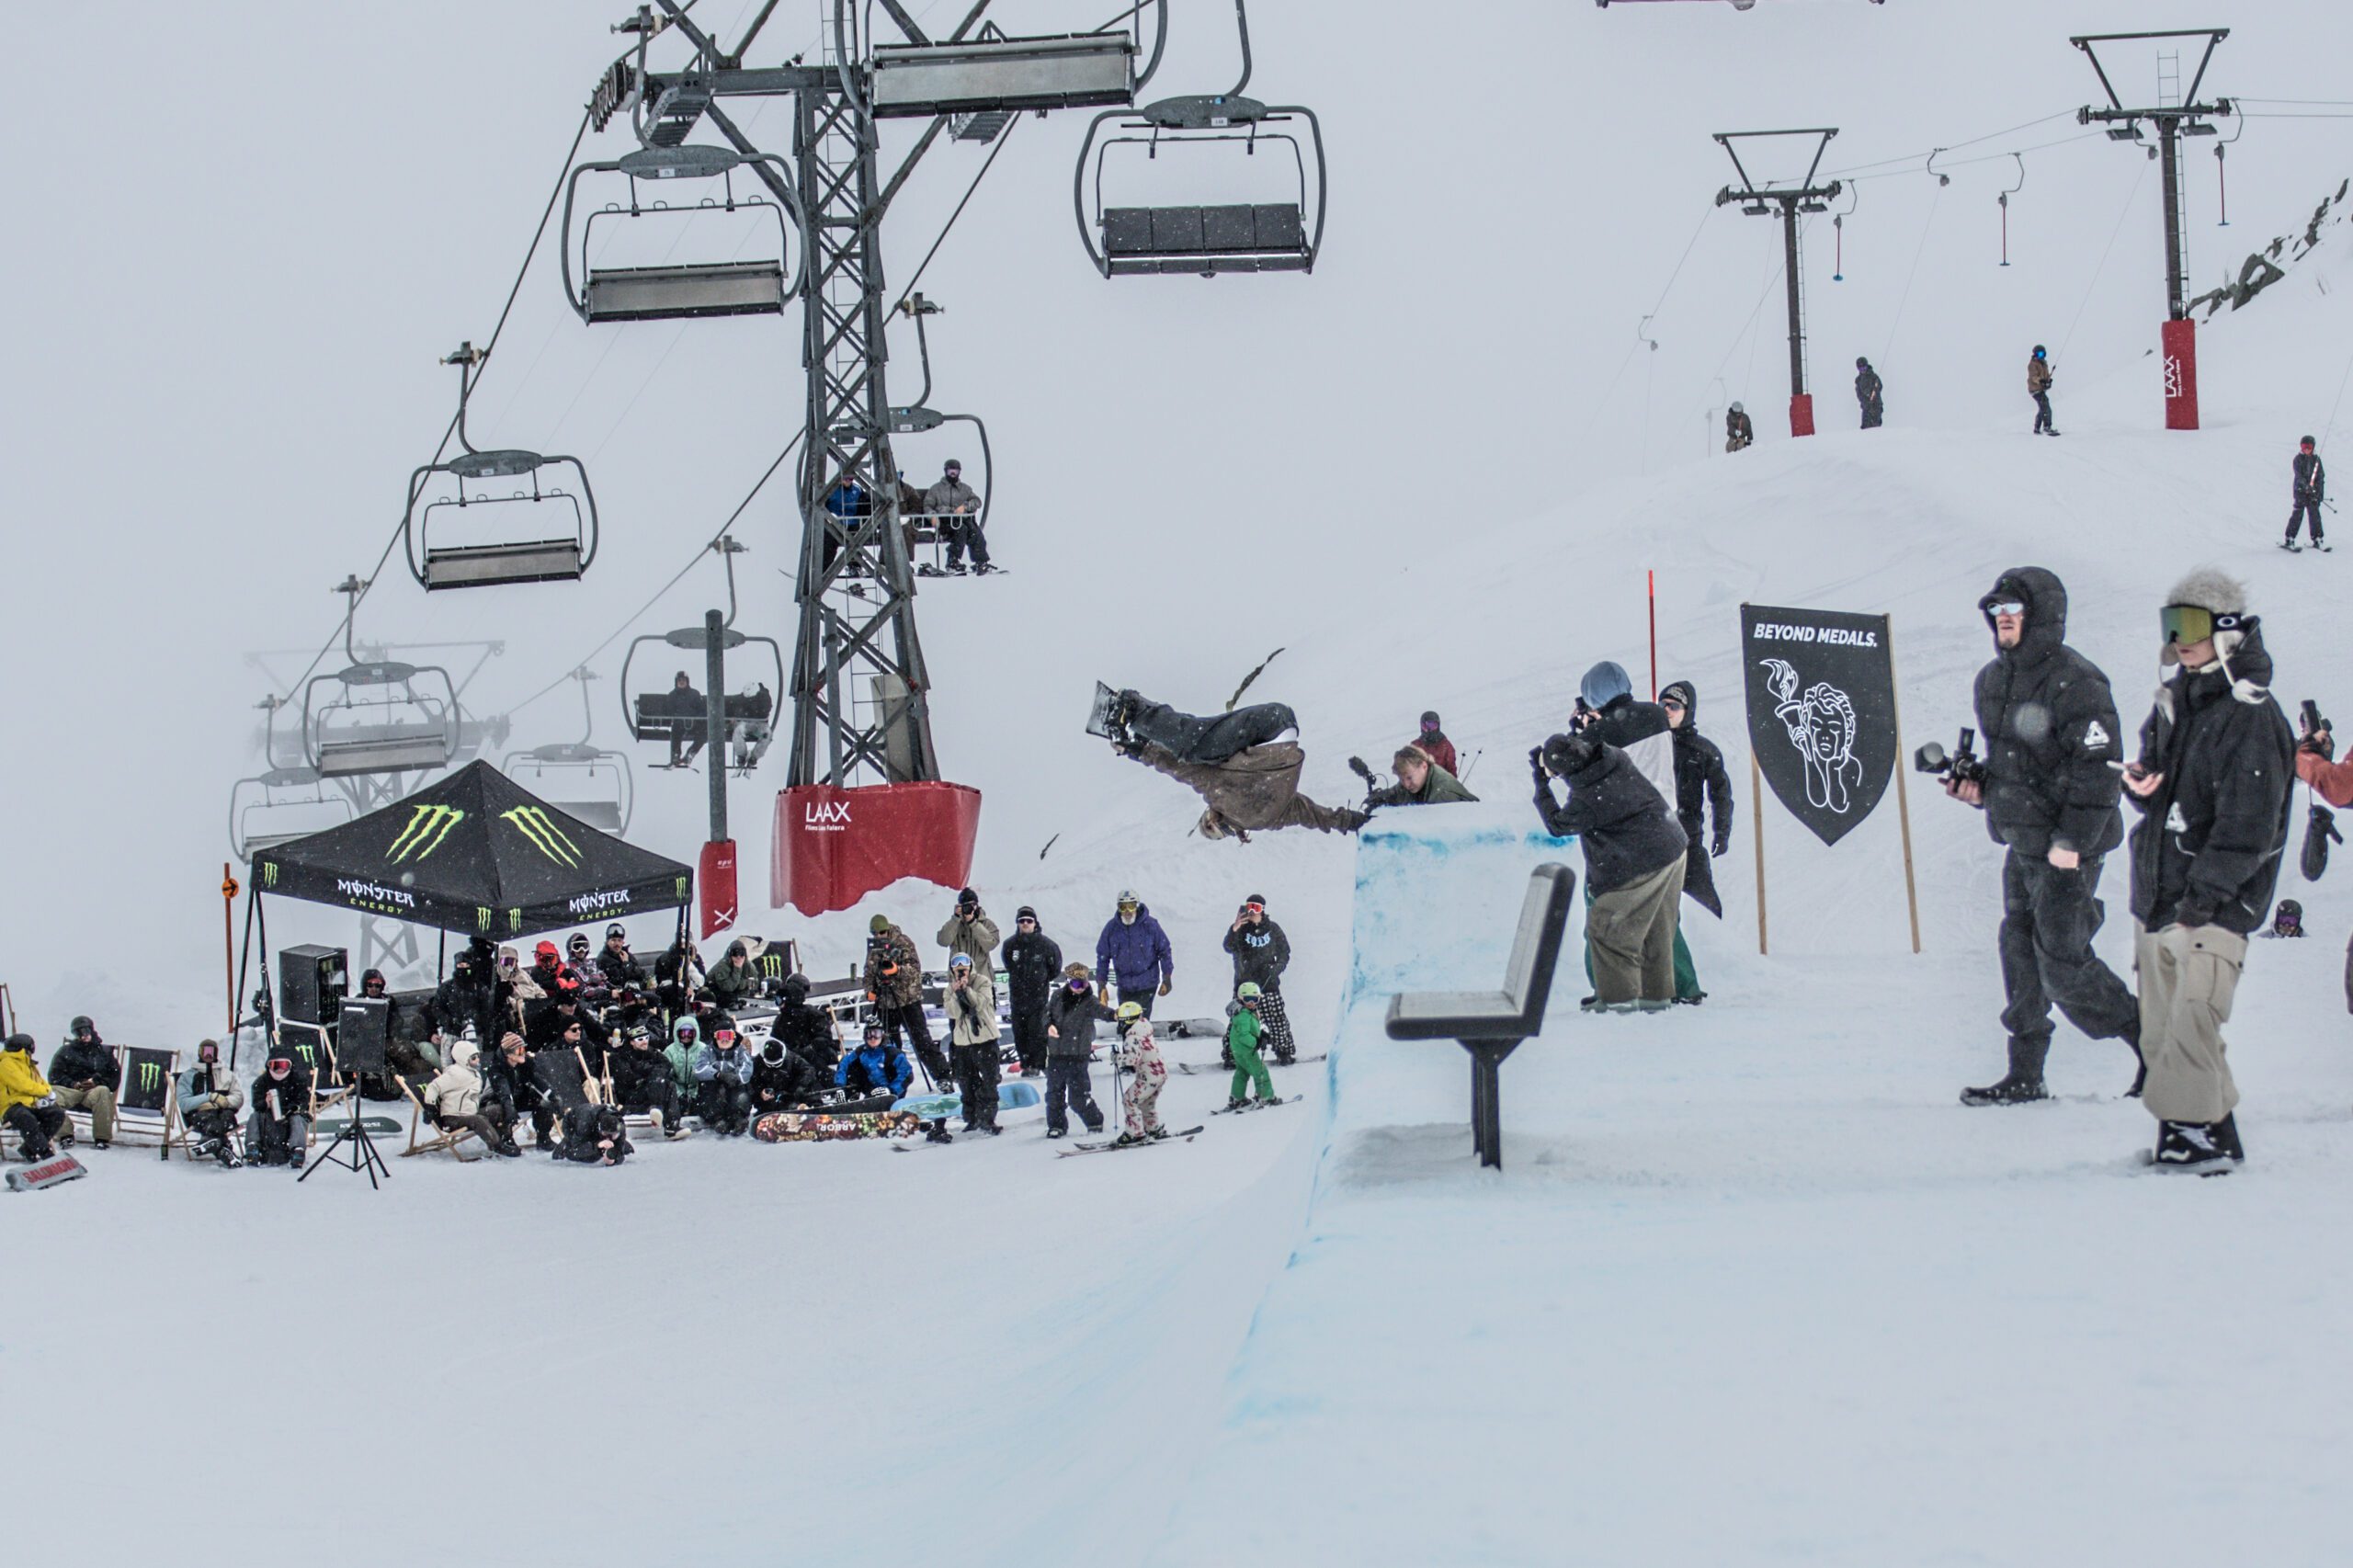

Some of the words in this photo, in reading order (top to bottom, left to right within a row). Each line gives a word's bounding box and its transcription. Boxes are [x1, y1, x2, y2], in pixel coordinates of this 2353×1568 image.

[2164, 355, 2177, 397] LAAX
[1754, 623, 1815, 642] BEYOND
[1817, 628, 1878, 647] MEDALS.
[806, 801, 852, 823] LAAX
[337, 879, 415, 907] MONSTER
[570, 889, 631, 913] MONSTER
[350, 898, 403, 915] ENERGY
